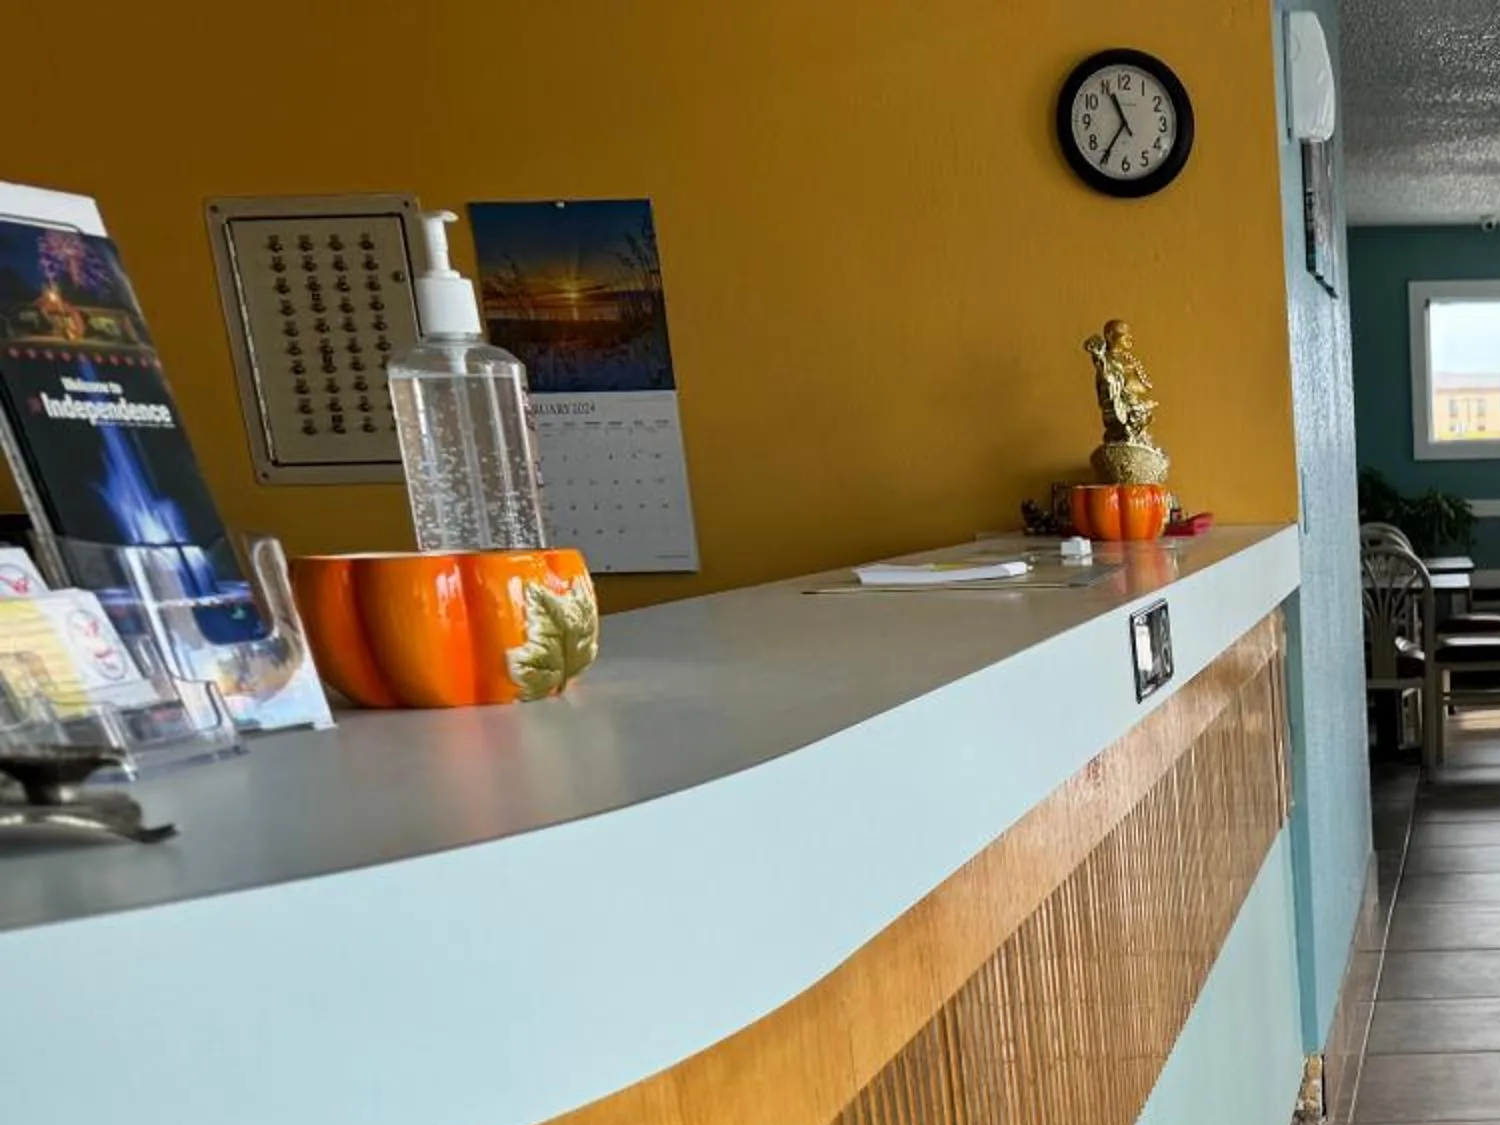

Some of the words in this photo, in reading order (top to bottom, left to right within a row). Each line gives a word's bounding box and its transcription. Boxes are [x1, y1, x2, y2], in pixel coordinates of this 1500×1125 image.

[1117, 73, 1131, 91] 12
[1085, 93, 1099, 110] 10
[1152, 95, 1162, 113] 2
[1082, 113, 1091, 131] 9
[1159, 115, 1167, 133] 3
[1088, 133, 1098, 151] 8
[1121, 155, 1131, 172] 6
[1139, 149, 1149, 167] 5
[40, 391, 172, 427] Independence
